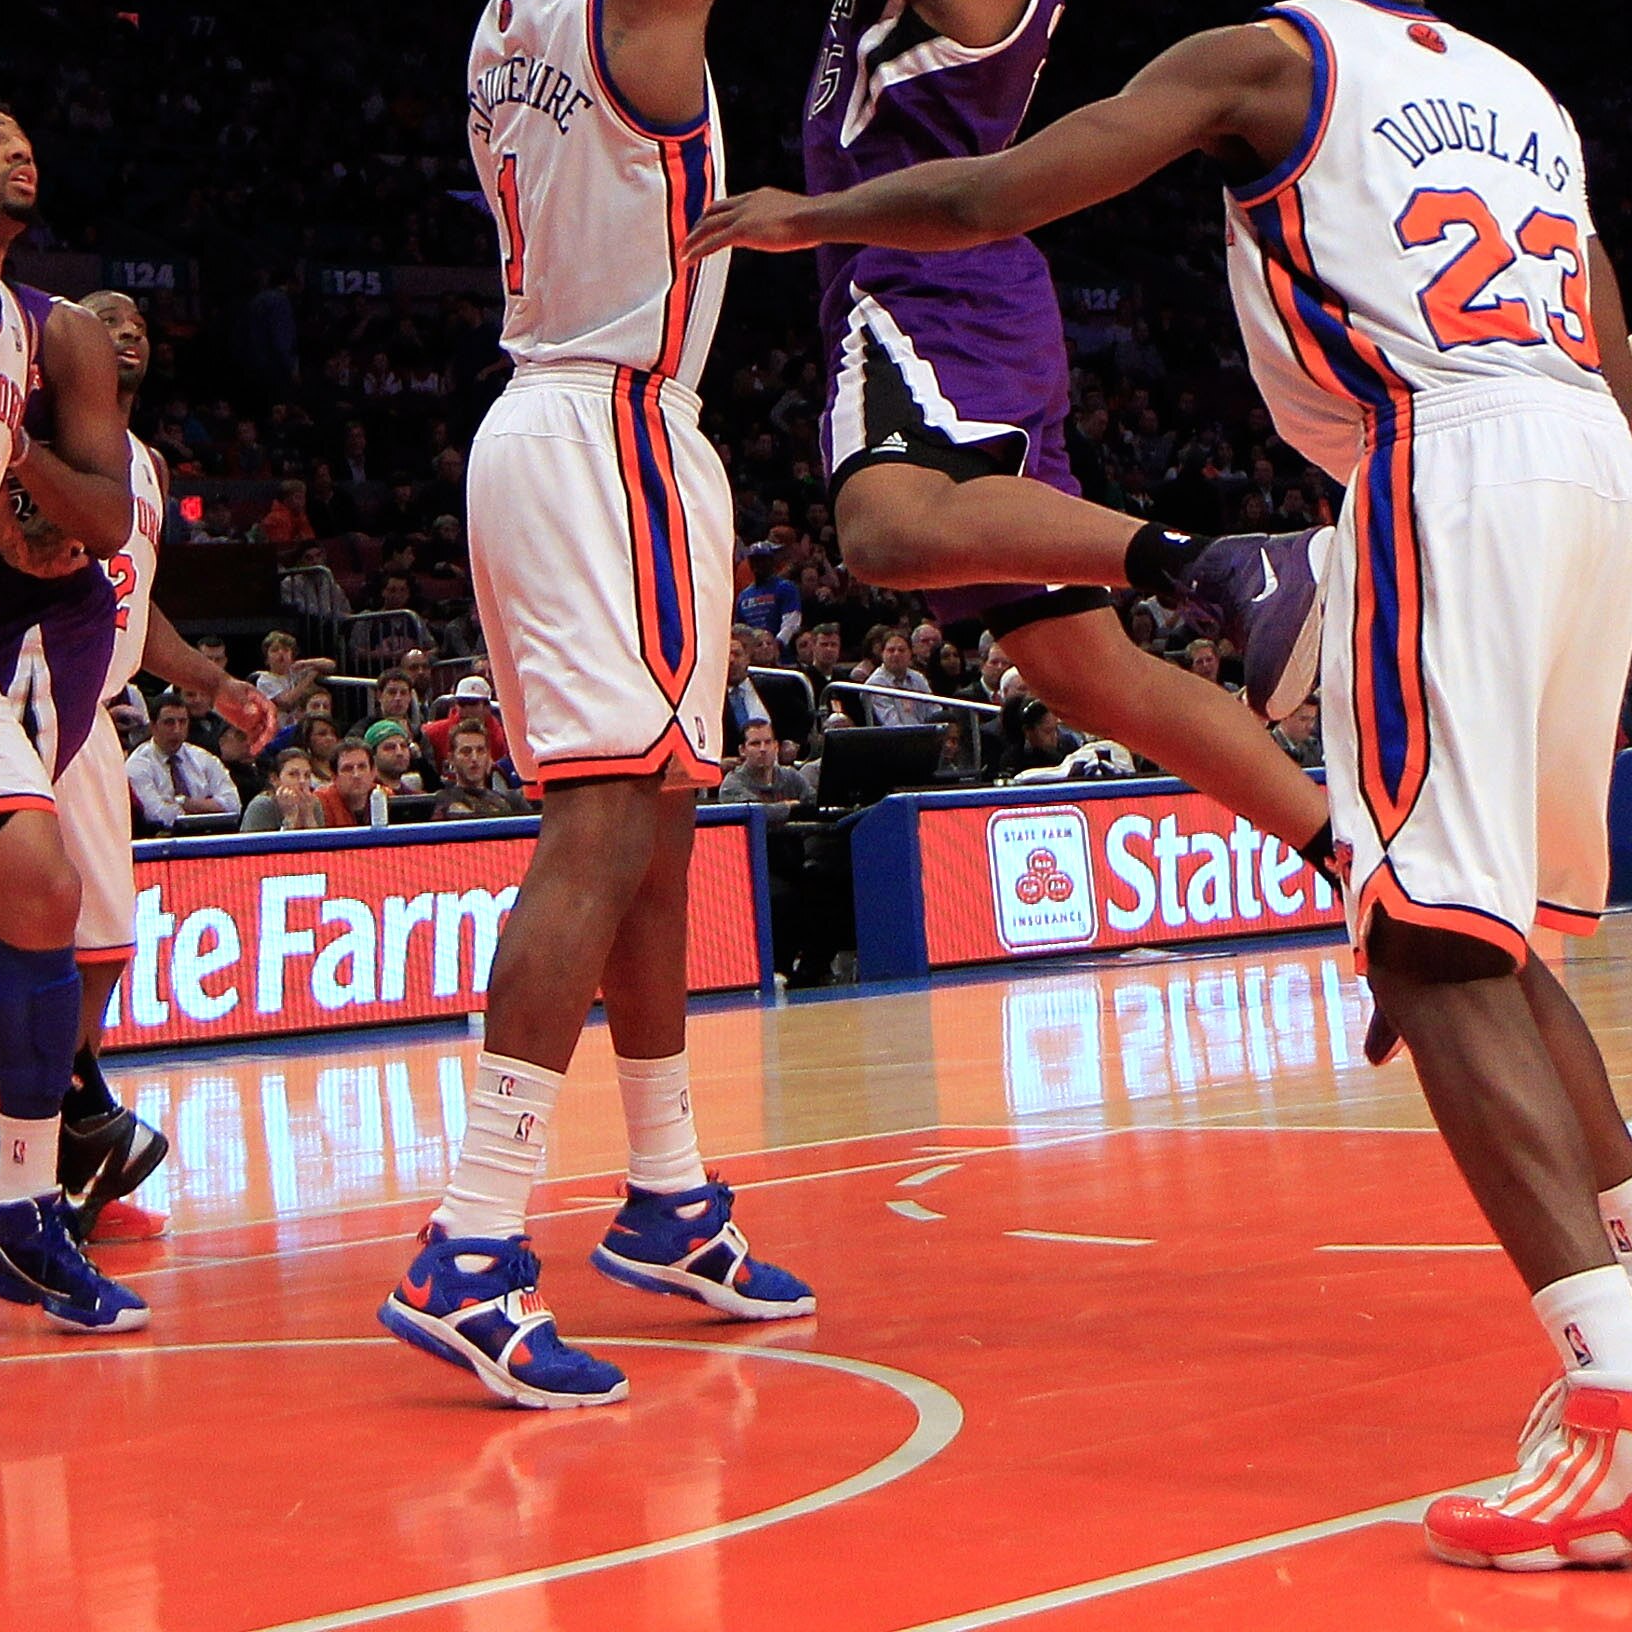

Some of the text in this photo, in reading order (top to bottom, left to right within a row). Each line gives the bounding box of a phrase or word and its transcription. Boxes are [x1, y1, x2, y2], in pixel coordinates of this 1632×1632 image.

[1371, 98, 1571, 194] DOUGLAS
[497, 153, 526, 297] 1
[123, 263, 176, 288] 124
[333, 271, 383, 297] 125
[1395, 185, 1602, 375] 23
[1003, 828, 1073, 843] STATE FARM
[1012, 910, 1083, 928] INSURANCE
